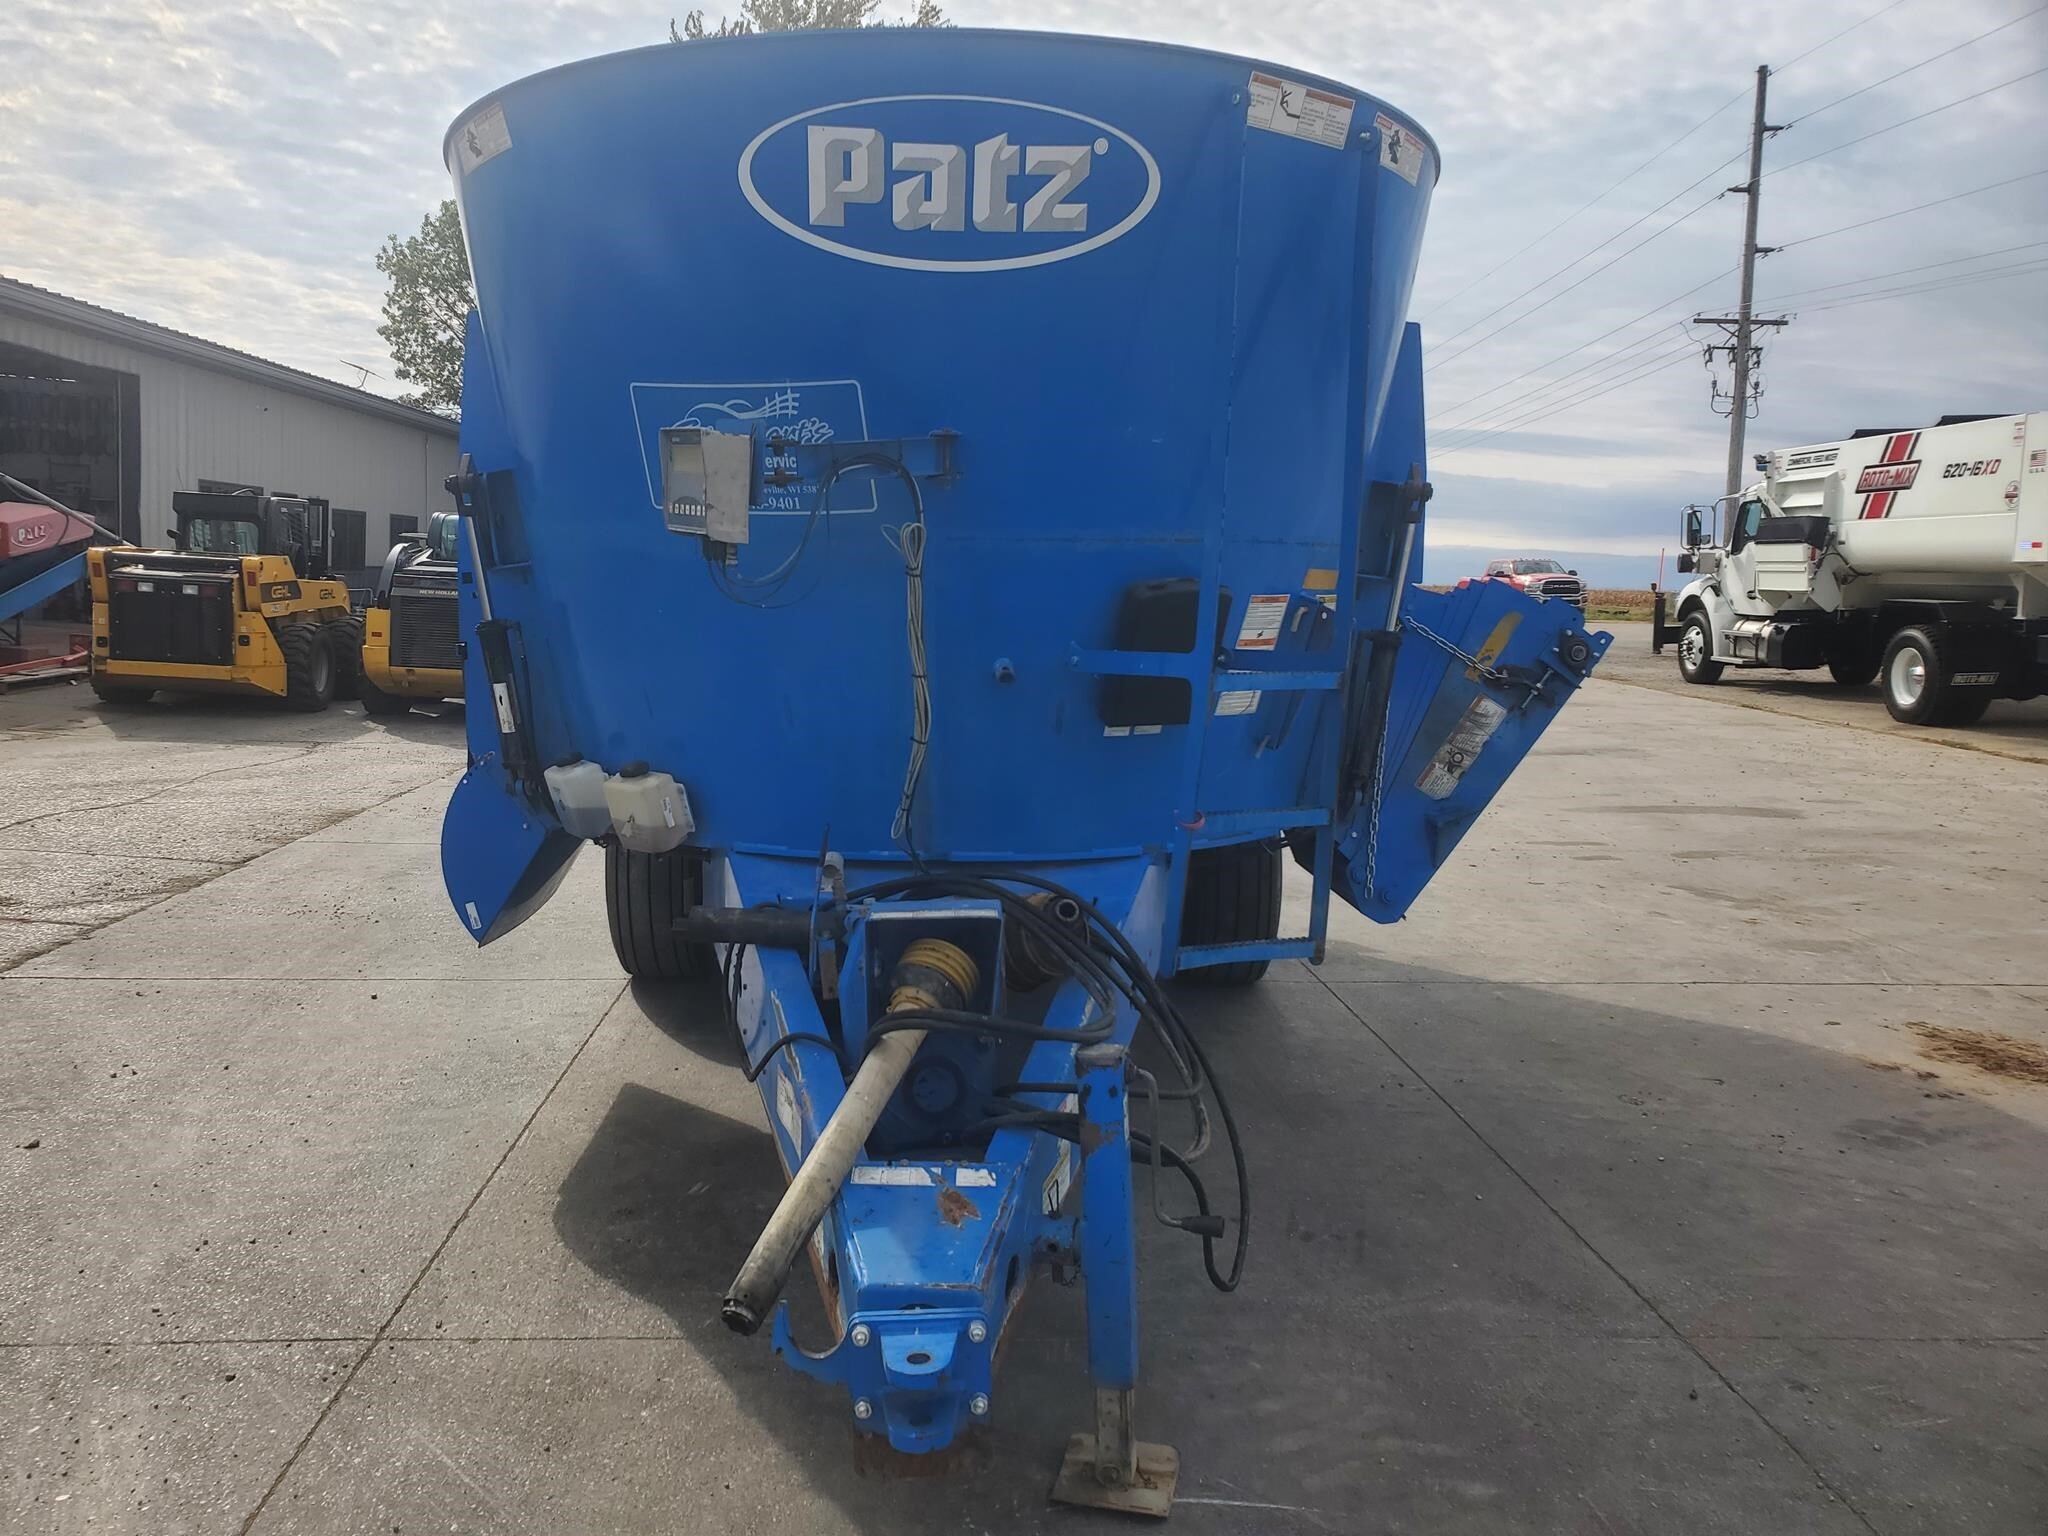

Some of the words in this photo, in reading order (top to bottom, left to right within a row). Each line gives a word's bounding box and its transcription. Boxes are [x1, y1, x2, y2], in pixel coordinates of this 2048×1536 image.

[764, 453, 798, 468] ervic
[1942, 458, 2002, 479] 620-16XD
[1860, 465, 1916, 489] ROTO-MIX
